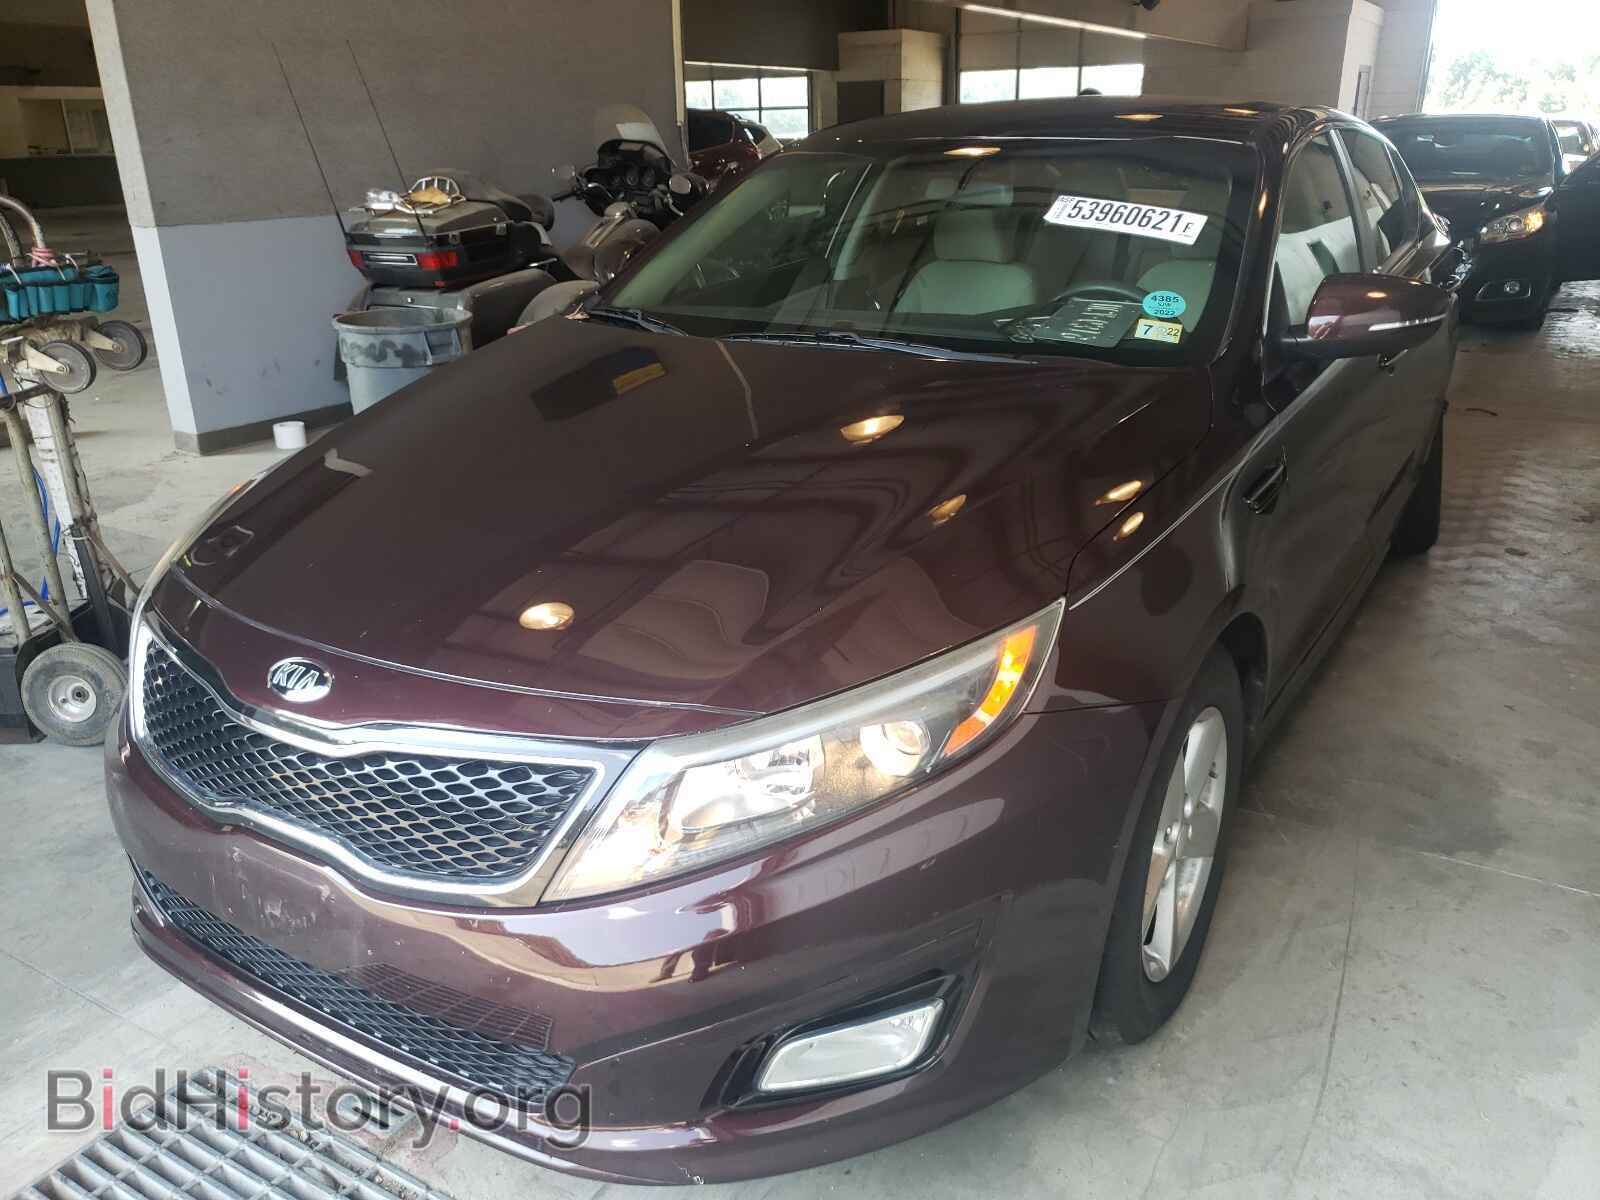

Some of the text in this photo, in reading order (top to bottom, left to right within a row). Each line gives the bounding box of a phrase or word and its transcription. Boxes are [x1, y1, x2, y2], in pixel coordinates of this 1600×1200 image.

[1067, 199, 1183, 233] 53960621
[1143, 324, 1180, 337] 7 22
[273, 660, 320, 690] KIA
